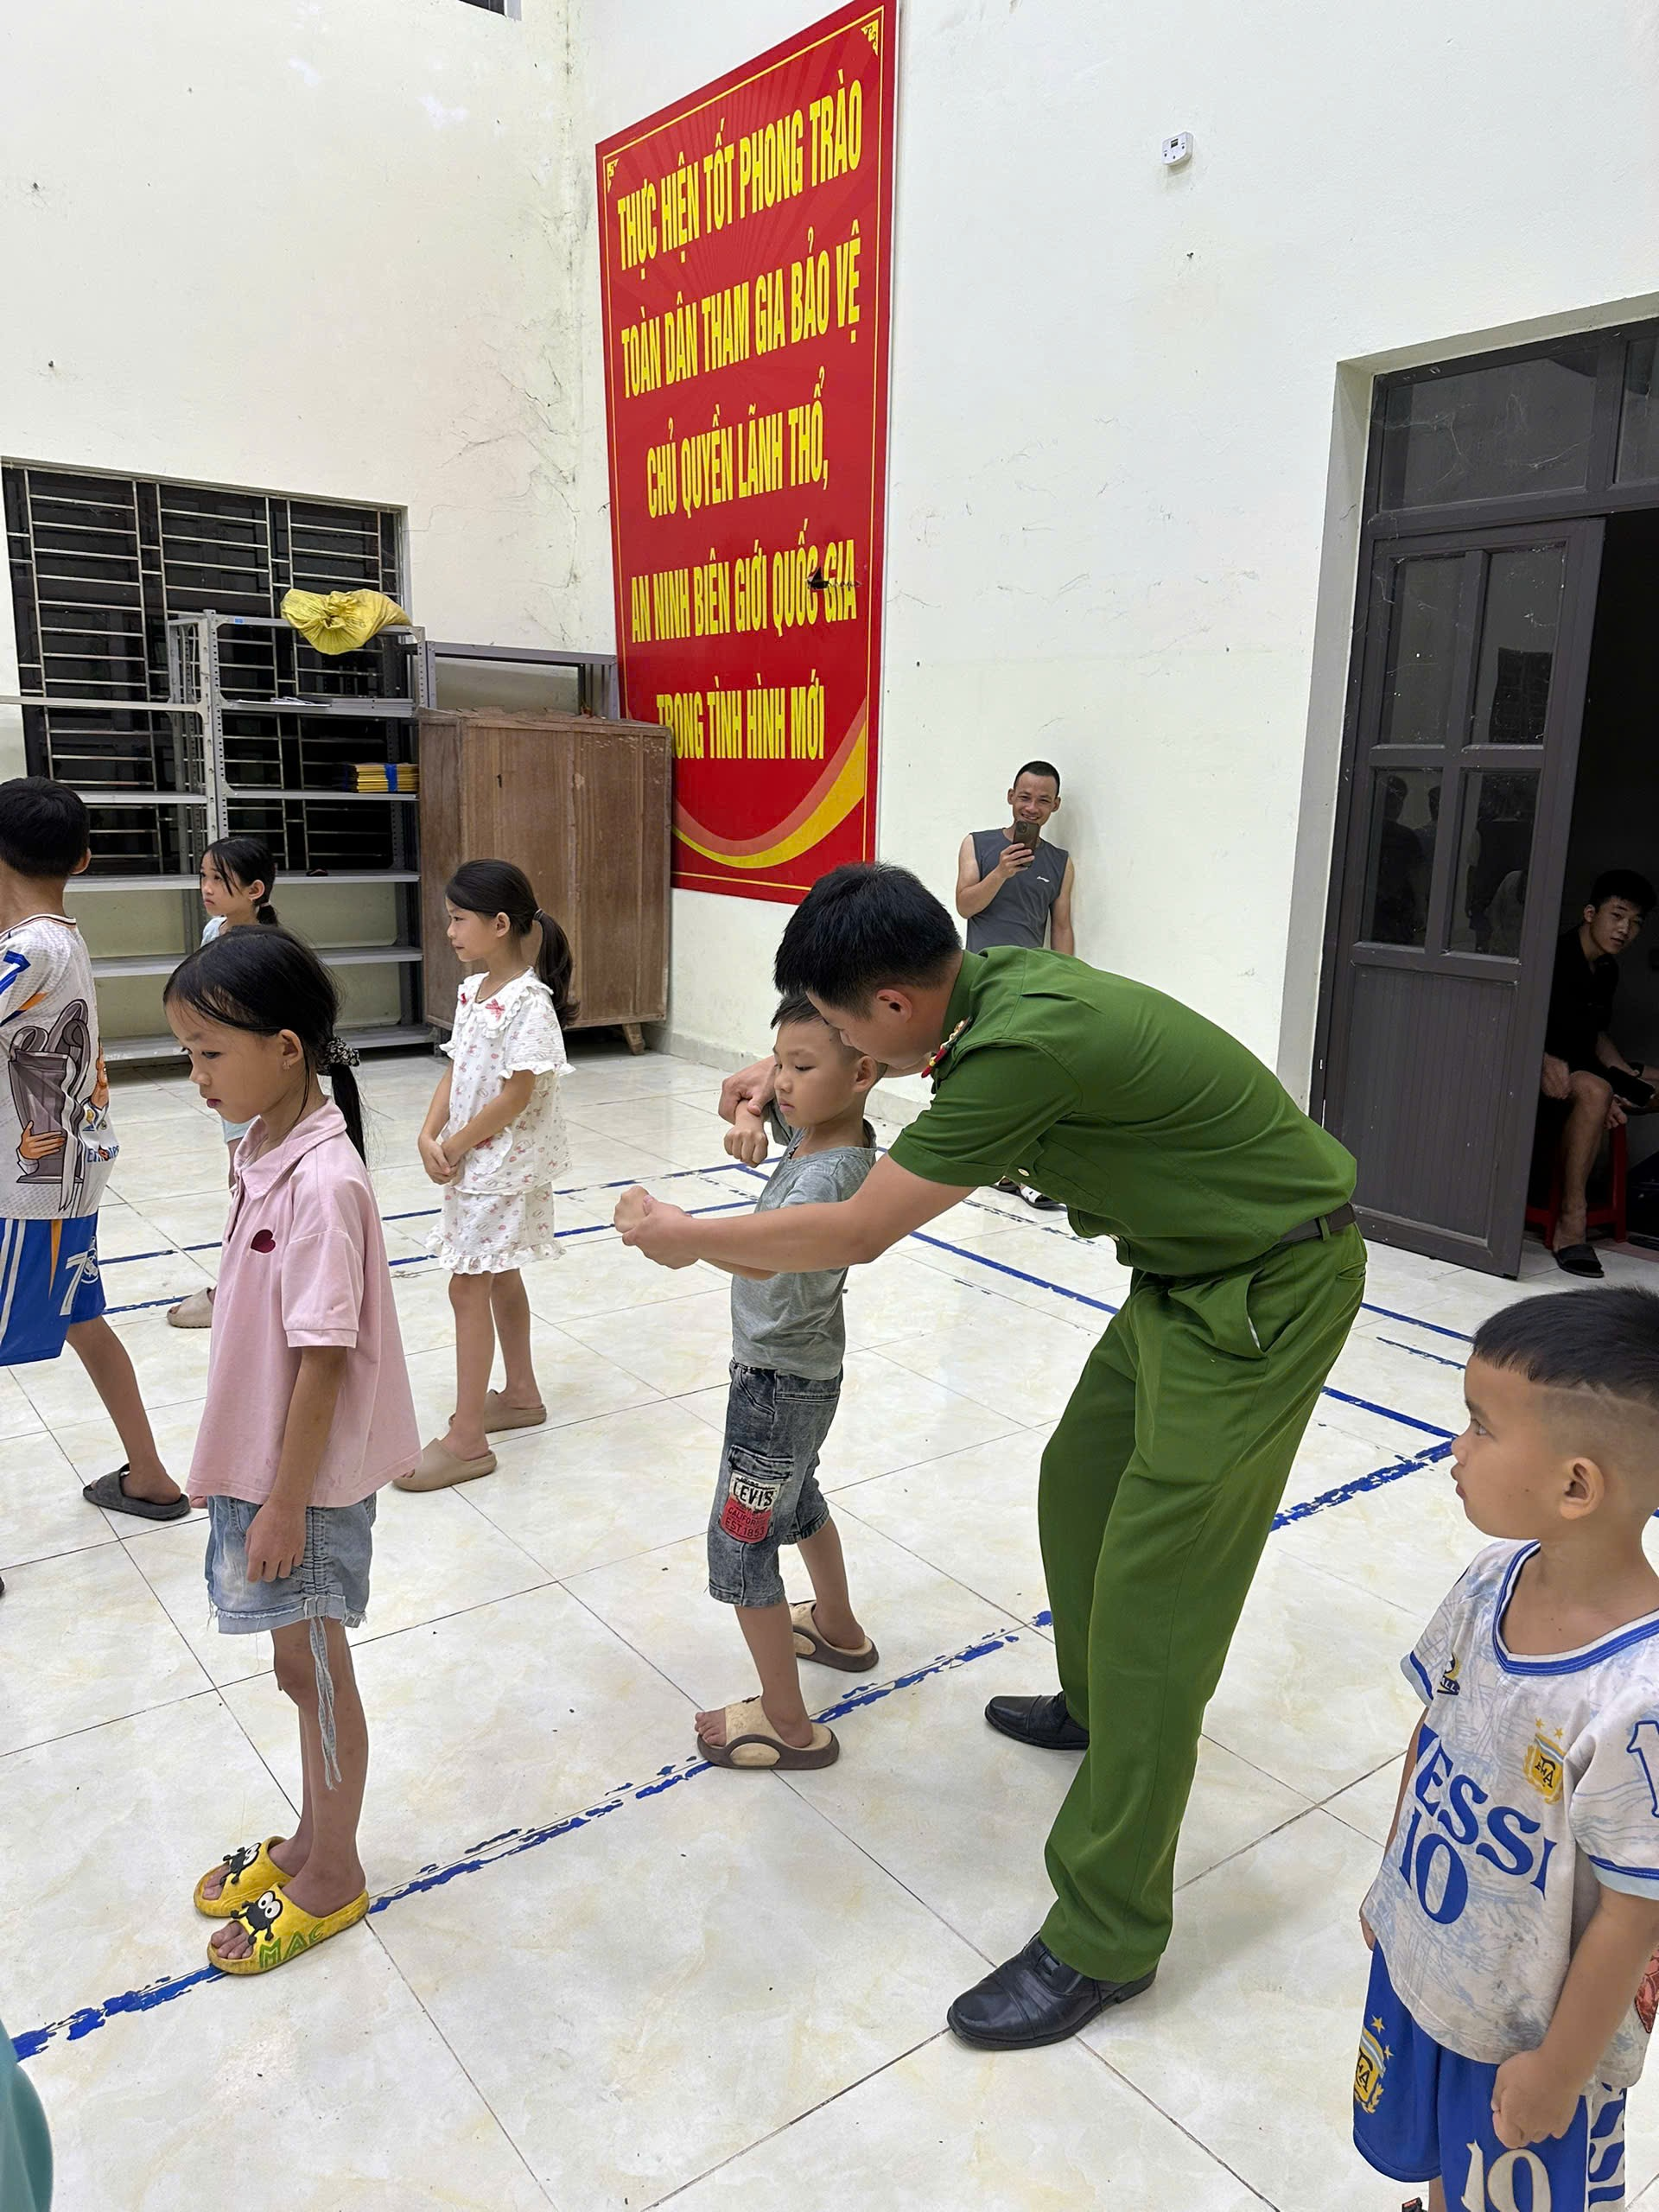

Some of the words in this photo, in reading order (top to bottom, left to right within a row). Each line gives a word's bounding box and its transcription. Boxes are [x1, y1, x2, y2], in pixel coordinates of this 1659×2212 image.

[618, 179, 658, 280] THỰC
[661, 151, 700, 263] HIỆN
[703, 118, 734, 234] TỐT
[740, 109, 803, 219] PHONG
[810, 69, 862, 188] TRÀO
[621, 306, 661, 398] TOÀN
[664, 291, 698, 383] DÂN
[702, 281, 750, 372] THAM
[754, 269, 785, 355] GIA
[791, 226, 830, 344] BẢO
[836, 219, 861, 344] VỆ
[646, 417, 677, 518] CHỦ
[680, 404, 733, 519] QUYỀN
[738, 404, 783, 498] LÃNH
[788, 366, 829, 491] THỔ,
[632, 575, 651, 643] AN
[653, 568, 690, 640] NINH
[694, 548, 730, 637] BIÊN
[734, 539, 767, 631] GIỚI
[772, 518, 818, 638] QUỐC
[823, 539, 857, 623] GIA
[707, 676, 742, 759] TÌNH
[747, 673, 785, 760] HÌNH
[791, 669, 824, 760] MỚI
[1399, 1807, 1468, 1924] 10
